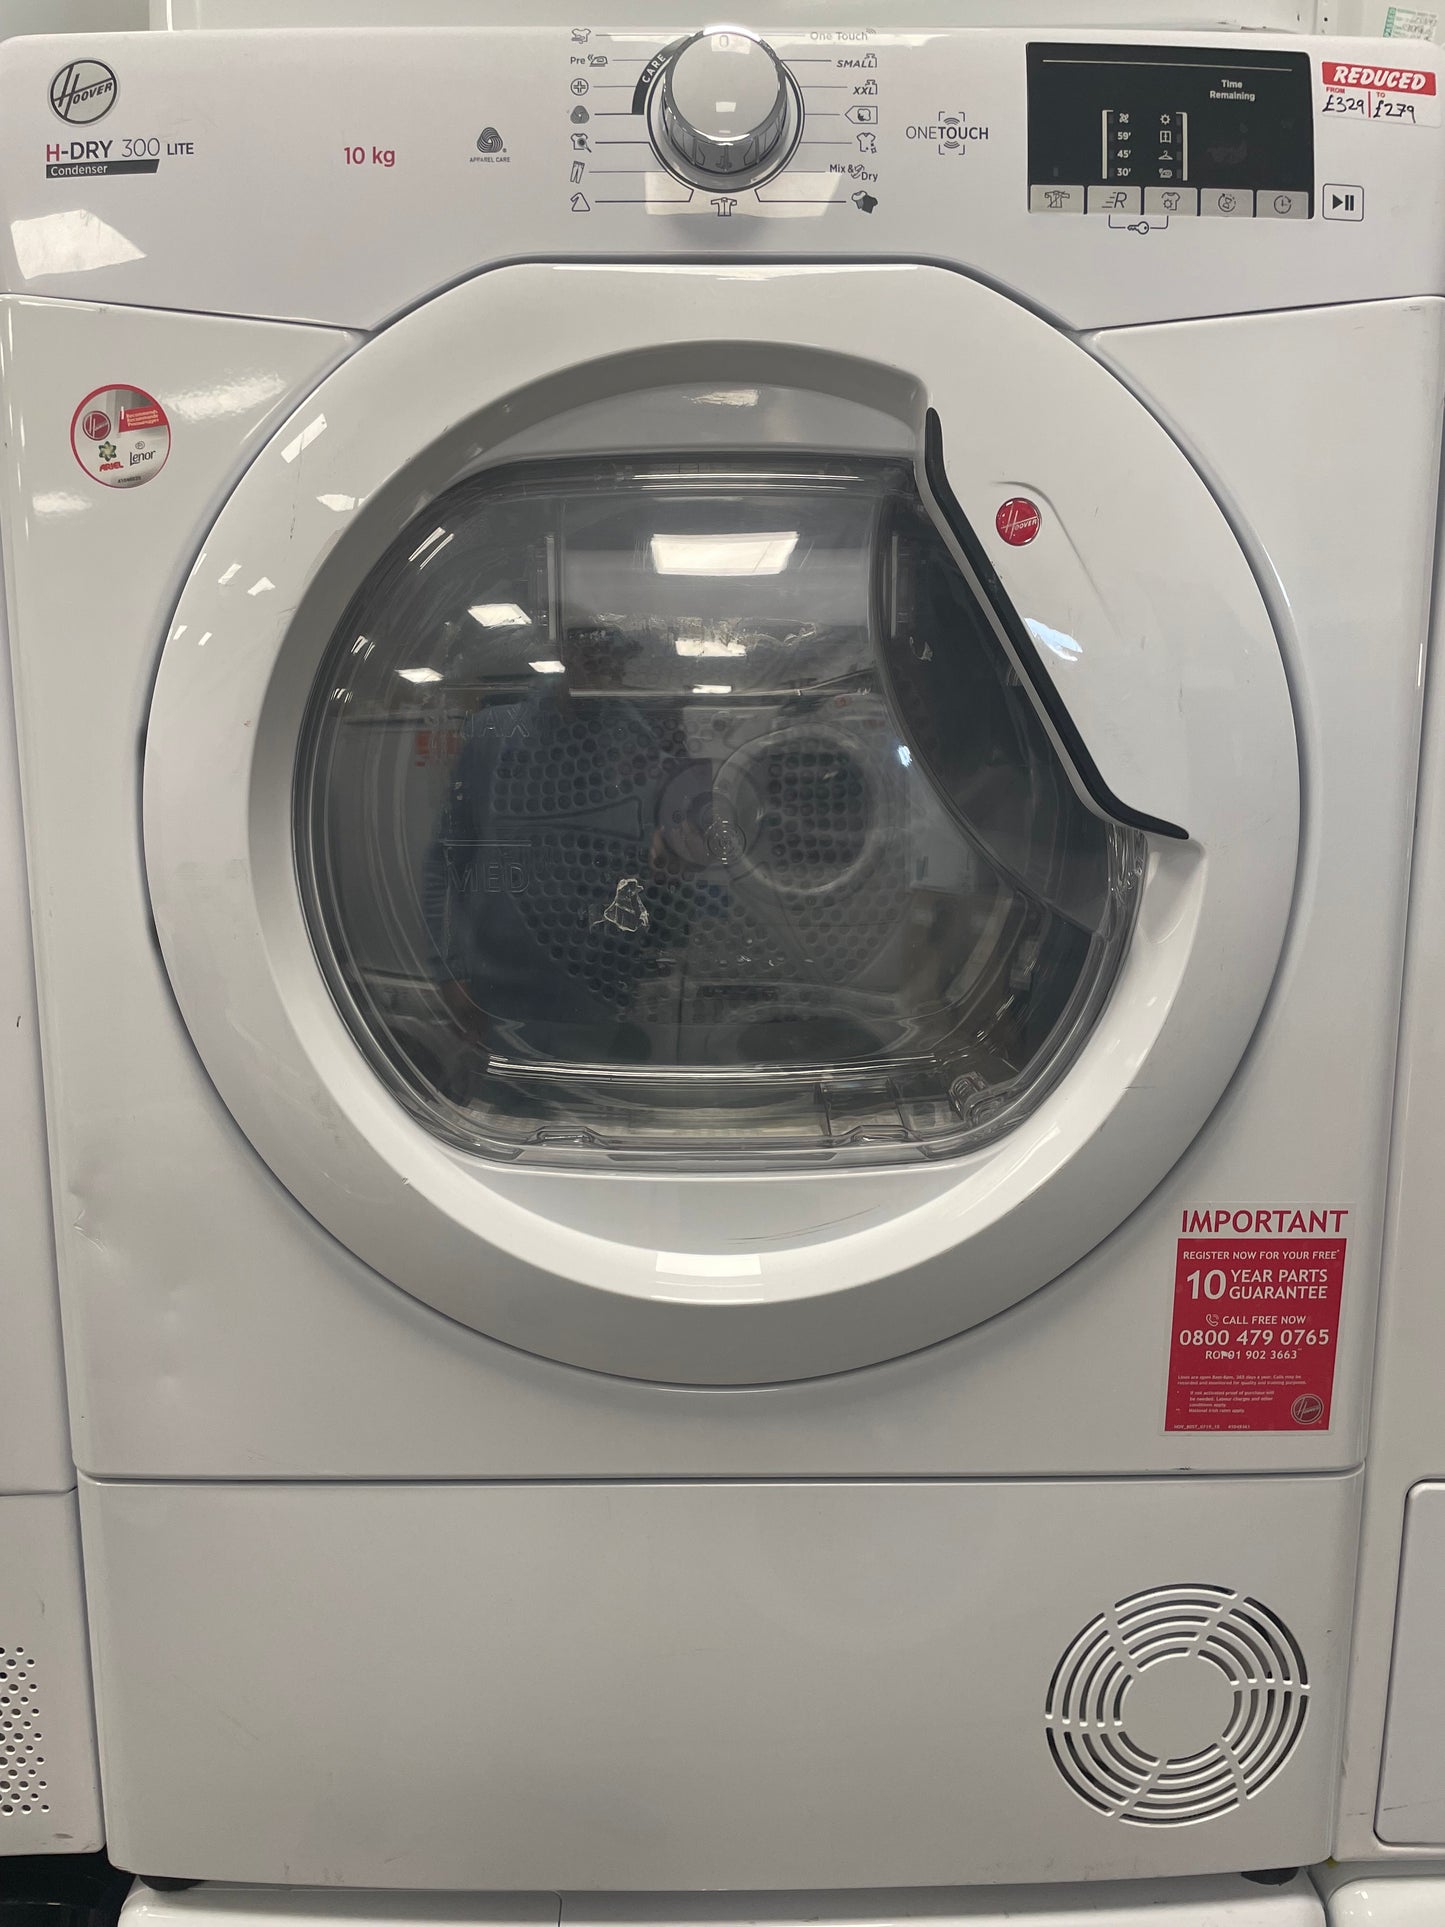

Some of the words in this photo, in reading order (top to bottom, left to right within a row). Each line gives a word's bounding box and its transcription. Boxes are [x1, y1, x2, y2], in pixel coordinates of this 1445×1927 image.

[810, 32, 832, 41] One
[836, 31, 868, 41] Touch
[570, 56, 585, 65] Pre
[836, 59, 874, 68] SMALL
[642, 54, 666, 83] CARE
[1221, 79, 1243, 88] Time
[1333, 65, 1426, 91] REDUCED
[853, 86, 874, 95] XXL
[1209, 90, 1256, 102] Remaining
[1326, 86, 1345, 94] FROM
[1321, 94, 1365, 115] £329
[1373, 100, 1416, 124] £279
[46, 139, 113, 162] H-DRY
[121, 137, 160, 157] 300
[167, 142, 194, 155] LITE
[344, 146, 365, 165] 10
[372, 146, 395, 167] kg
[50, 164, 108, 176] Condenser
[829, 163, 846, 173] Mix
[847, 164, 854, 173] &
[861, 171, 878, 182] Dry
[129, 450, 156, 466] Lenor
[1181, 1209, 1349, 1233] IMPORTANT
[1183, 1251, 1229, 1260] REGISTER
[1233, 1251, 1256, 1260] NOW
[1260, 1251, 1279, 1260] FOR
[1282, 1251, 1309, 1260] YOUR
[1231, 1269, 1273, 1282] YEAR
[1278, 1269, 1328, 1282] PARTS
[1186, 1269, 1227, 1299] 10
[1229, 1286, 1328, 1299] GUARANTEE
[1222, 1315, 1248, 1325] CALL
[1251, 1315, 1278, 1325] FREE
[1281, 1315, 1306, 1325] NOW
[1179, 1329, 1230, 1345] 0800
[1236, 1329, 1273, 1345] 479
[1280, 1329, 1329, 1345] 0765
[1246, 1350, 1266, 1359] 902
